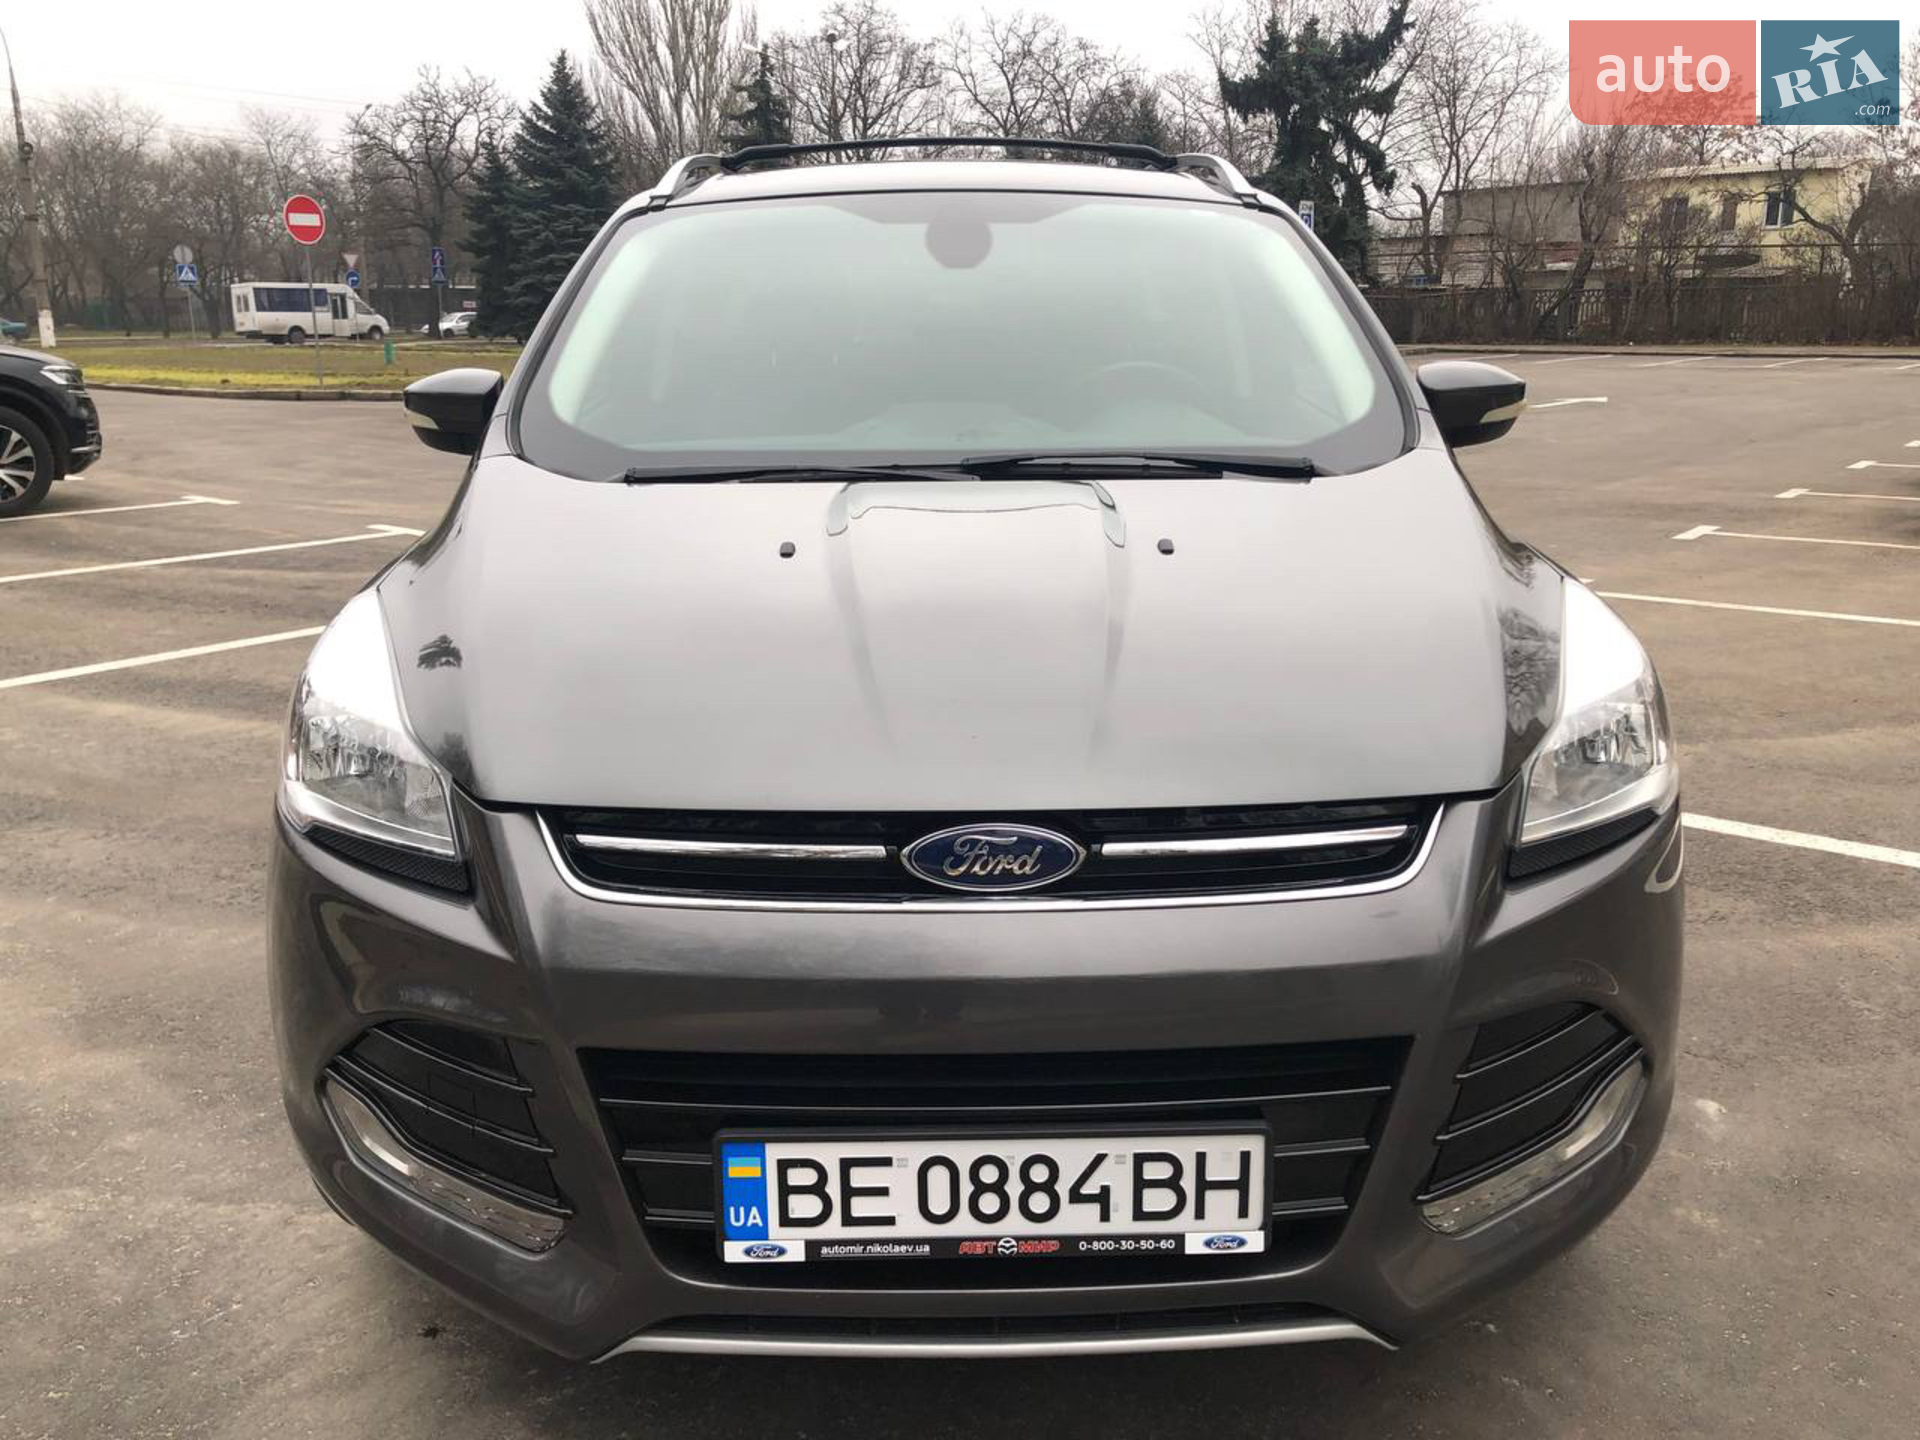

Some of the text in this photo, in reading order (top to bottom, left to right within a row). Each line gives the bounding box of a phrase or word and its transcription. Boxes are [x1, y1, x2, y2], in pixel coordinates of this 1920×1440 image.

[943, 835, 1043, 876] Ford
[777, 1150, 1251, 1228] BE 0884 BH
[729, 1206, 763, 1227] UA
[1078, 1239, 1176, 1251] 0-800-30-50-60
[1211, 1235, 1240, 1249] Ford
[750, 1245, 780, 1258] Ford
[820, 1243, 931, 1256] automir.nikolaev.ua
